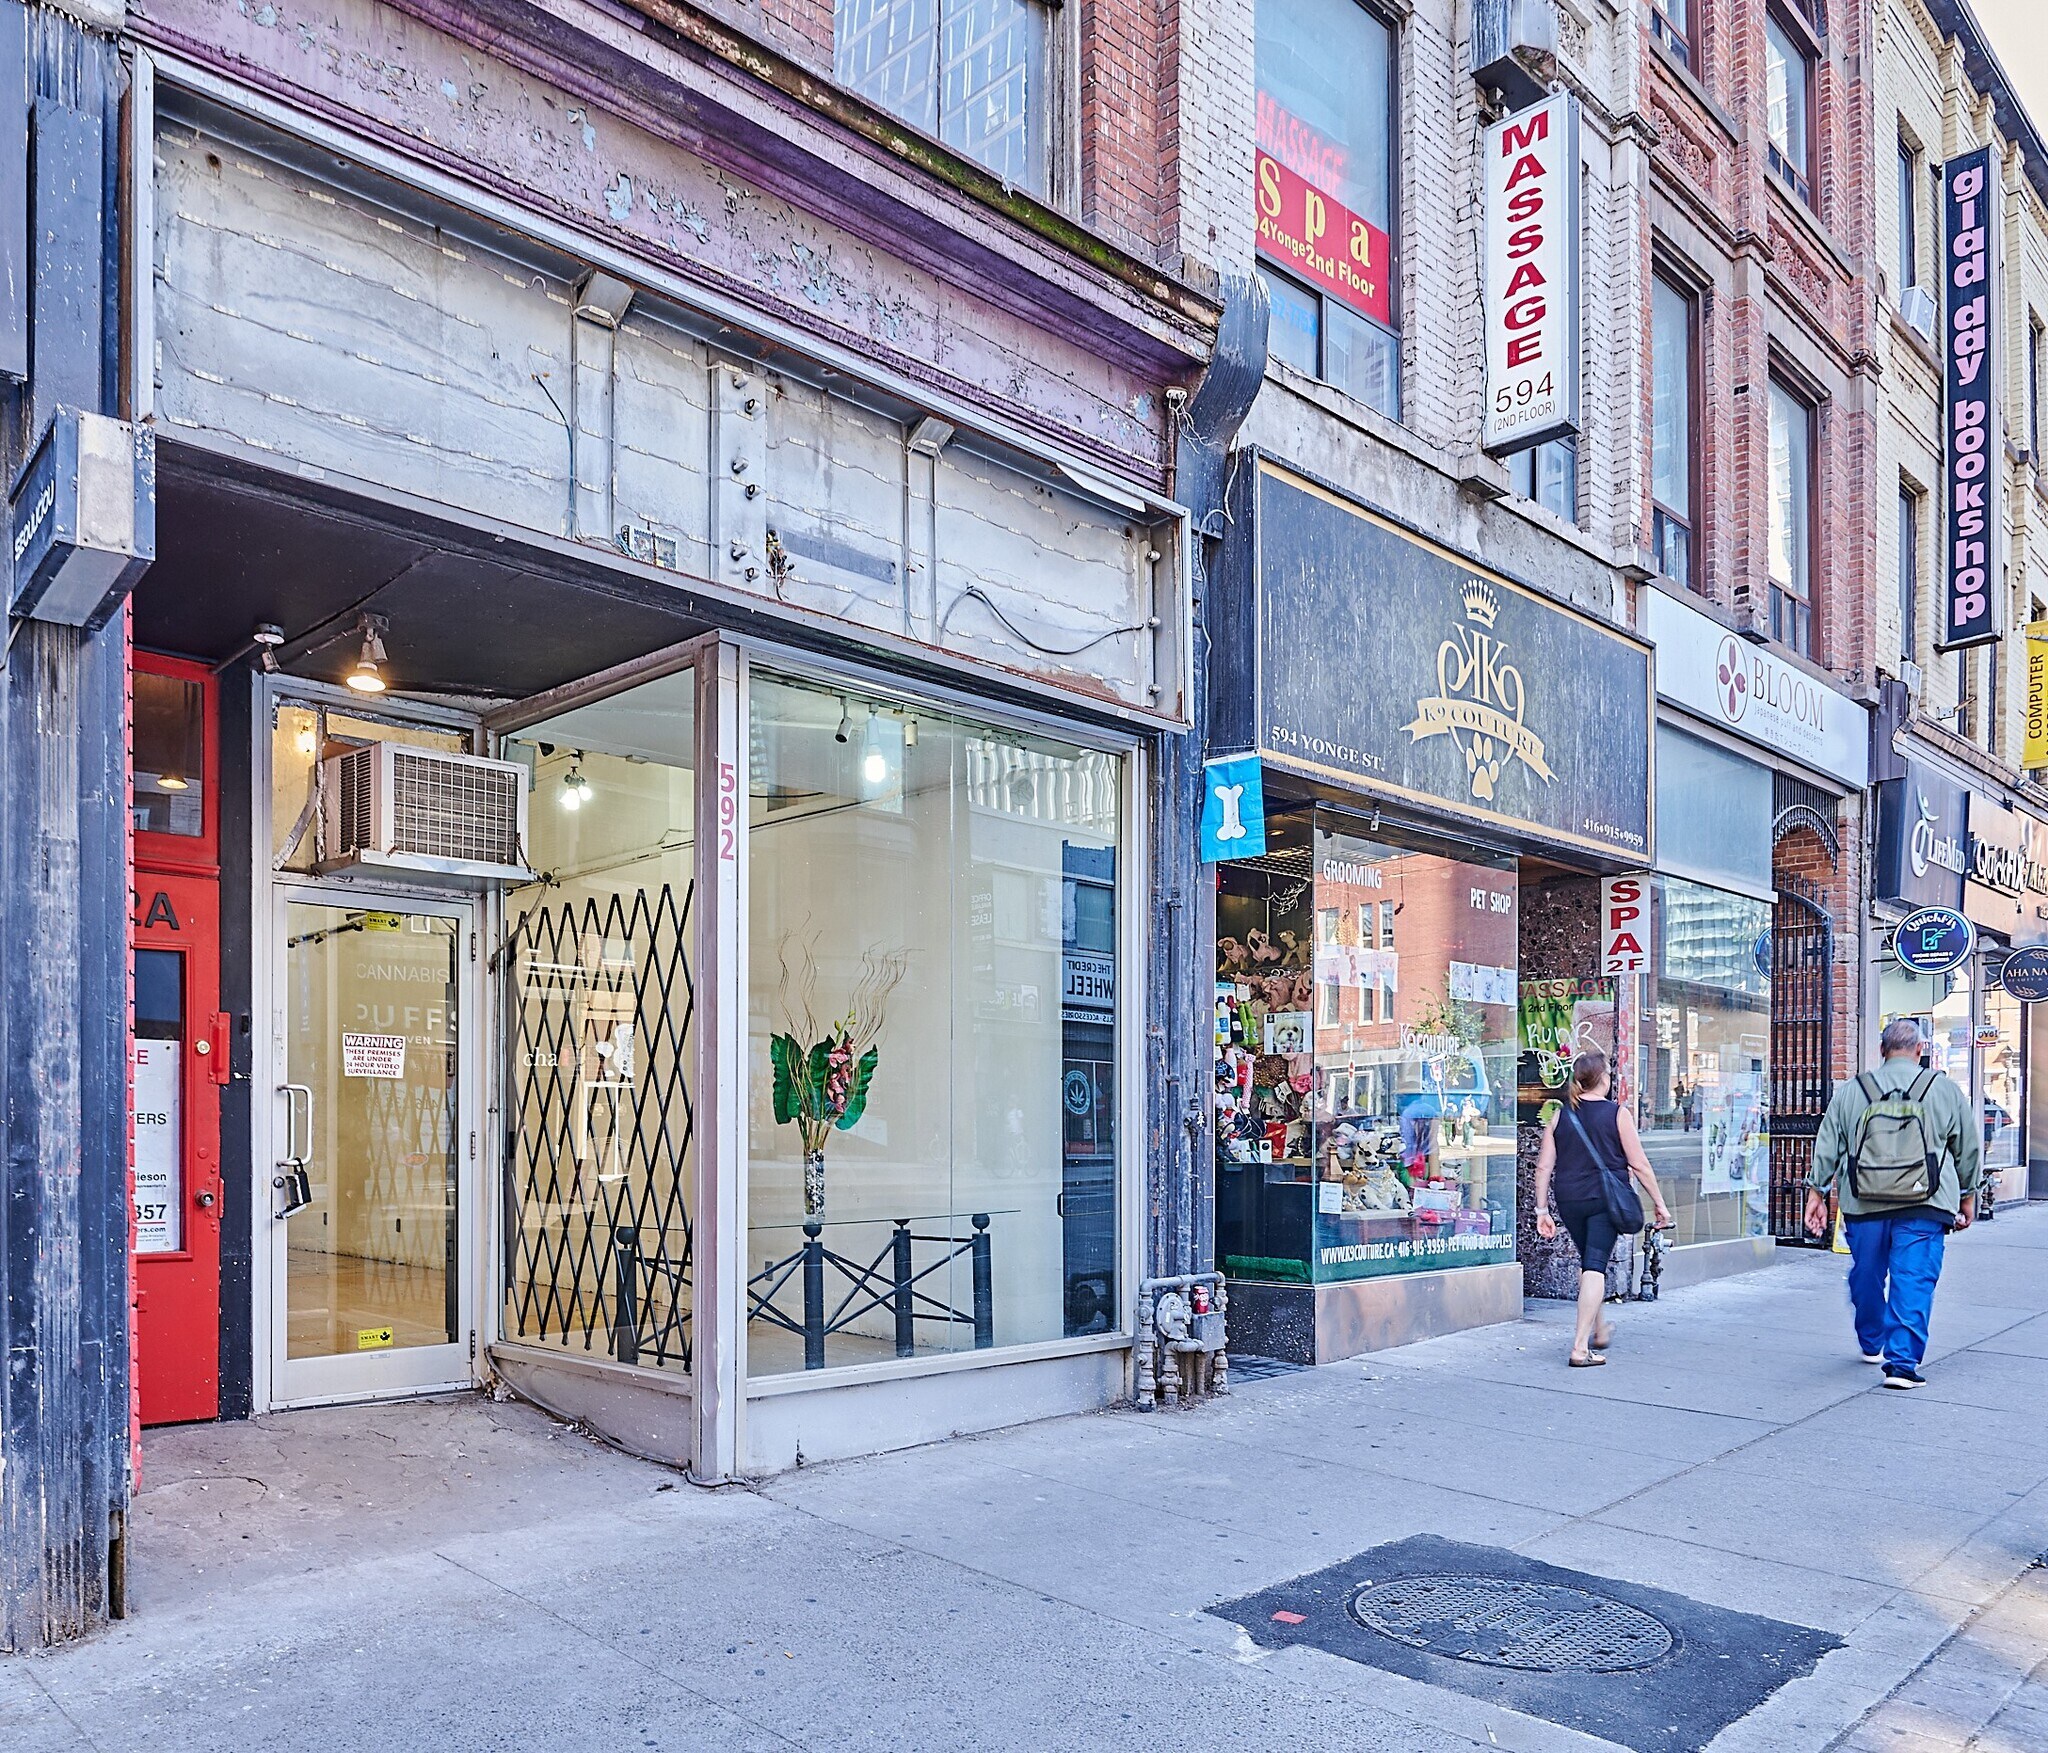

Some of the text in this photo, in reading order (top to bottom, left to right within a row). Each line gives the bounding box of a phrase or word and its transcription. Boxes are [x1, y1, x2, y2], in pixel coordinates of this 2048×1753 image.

[1256, 89, 1343, 194] MASSAGE
[1259, 157, 1371, 267] Spa
[1502, 109, 1549, 370] MASSAGE
[1339, 260, 1375, 298] Floor
[1496, 370, 1554, 413] 594
[1953, 165, 1986, 626] glad day bookshop
[1493, 401, 1556, 434] (2ND FLOOR)
[1754, 657, 1824, 732] BLOOM
[2028, 654, 2044, 739] COMPUTER
[1271, 726, 1386, 772] 594 YONGE ST.
[1424, 706, 1542, 760] K9 COUTURE
[720, 763, 735, 860] 592
[1323, 859, 1382, 889] GROOMING
[1470, 888, 1512, 915] PET SHOP
[1607, 879, 1644, 956] SPA
[356, 963, 450, 983] CANNABIS
[2006, 968, 2029, 977] AHA
[1528, 1003, 1545, 1013] 2nd
[345, 1035, 403, 1048] WARNING
[367, 1049, 401, 1057] PREMISES
[347, 1068, 397, 1076] SURVEILLANCE
[377, 1062, 400, 1070] VIDEO
